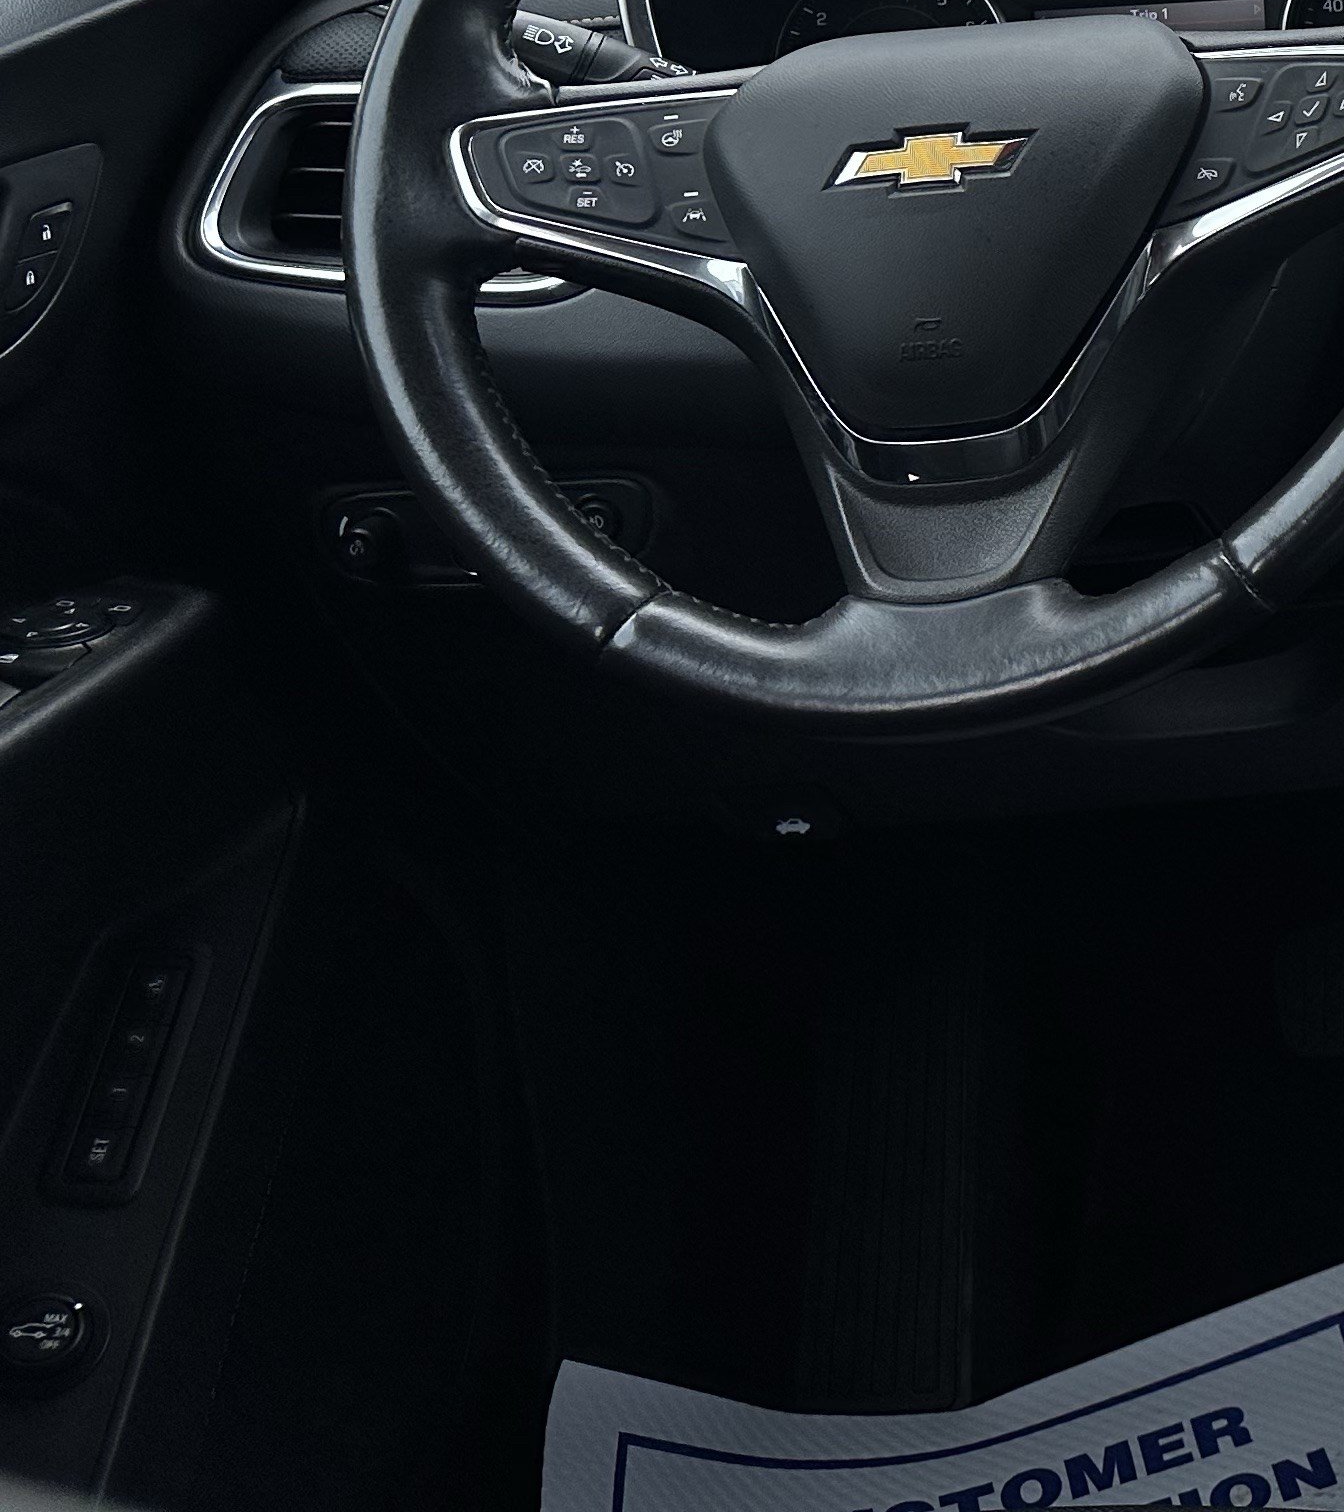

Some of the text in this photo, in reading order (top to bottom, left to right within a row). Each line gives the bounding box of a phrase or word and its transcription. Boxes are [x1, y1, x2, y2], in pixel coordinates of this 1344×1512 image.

[816, 12, 827, 26] 2
[1130, 8, 1169, 20] Trip 1
[563, 133, 585, 144] RES
[576, 197, 598, 208] SET
[851, 1405, 1255, 1512] TOMER
